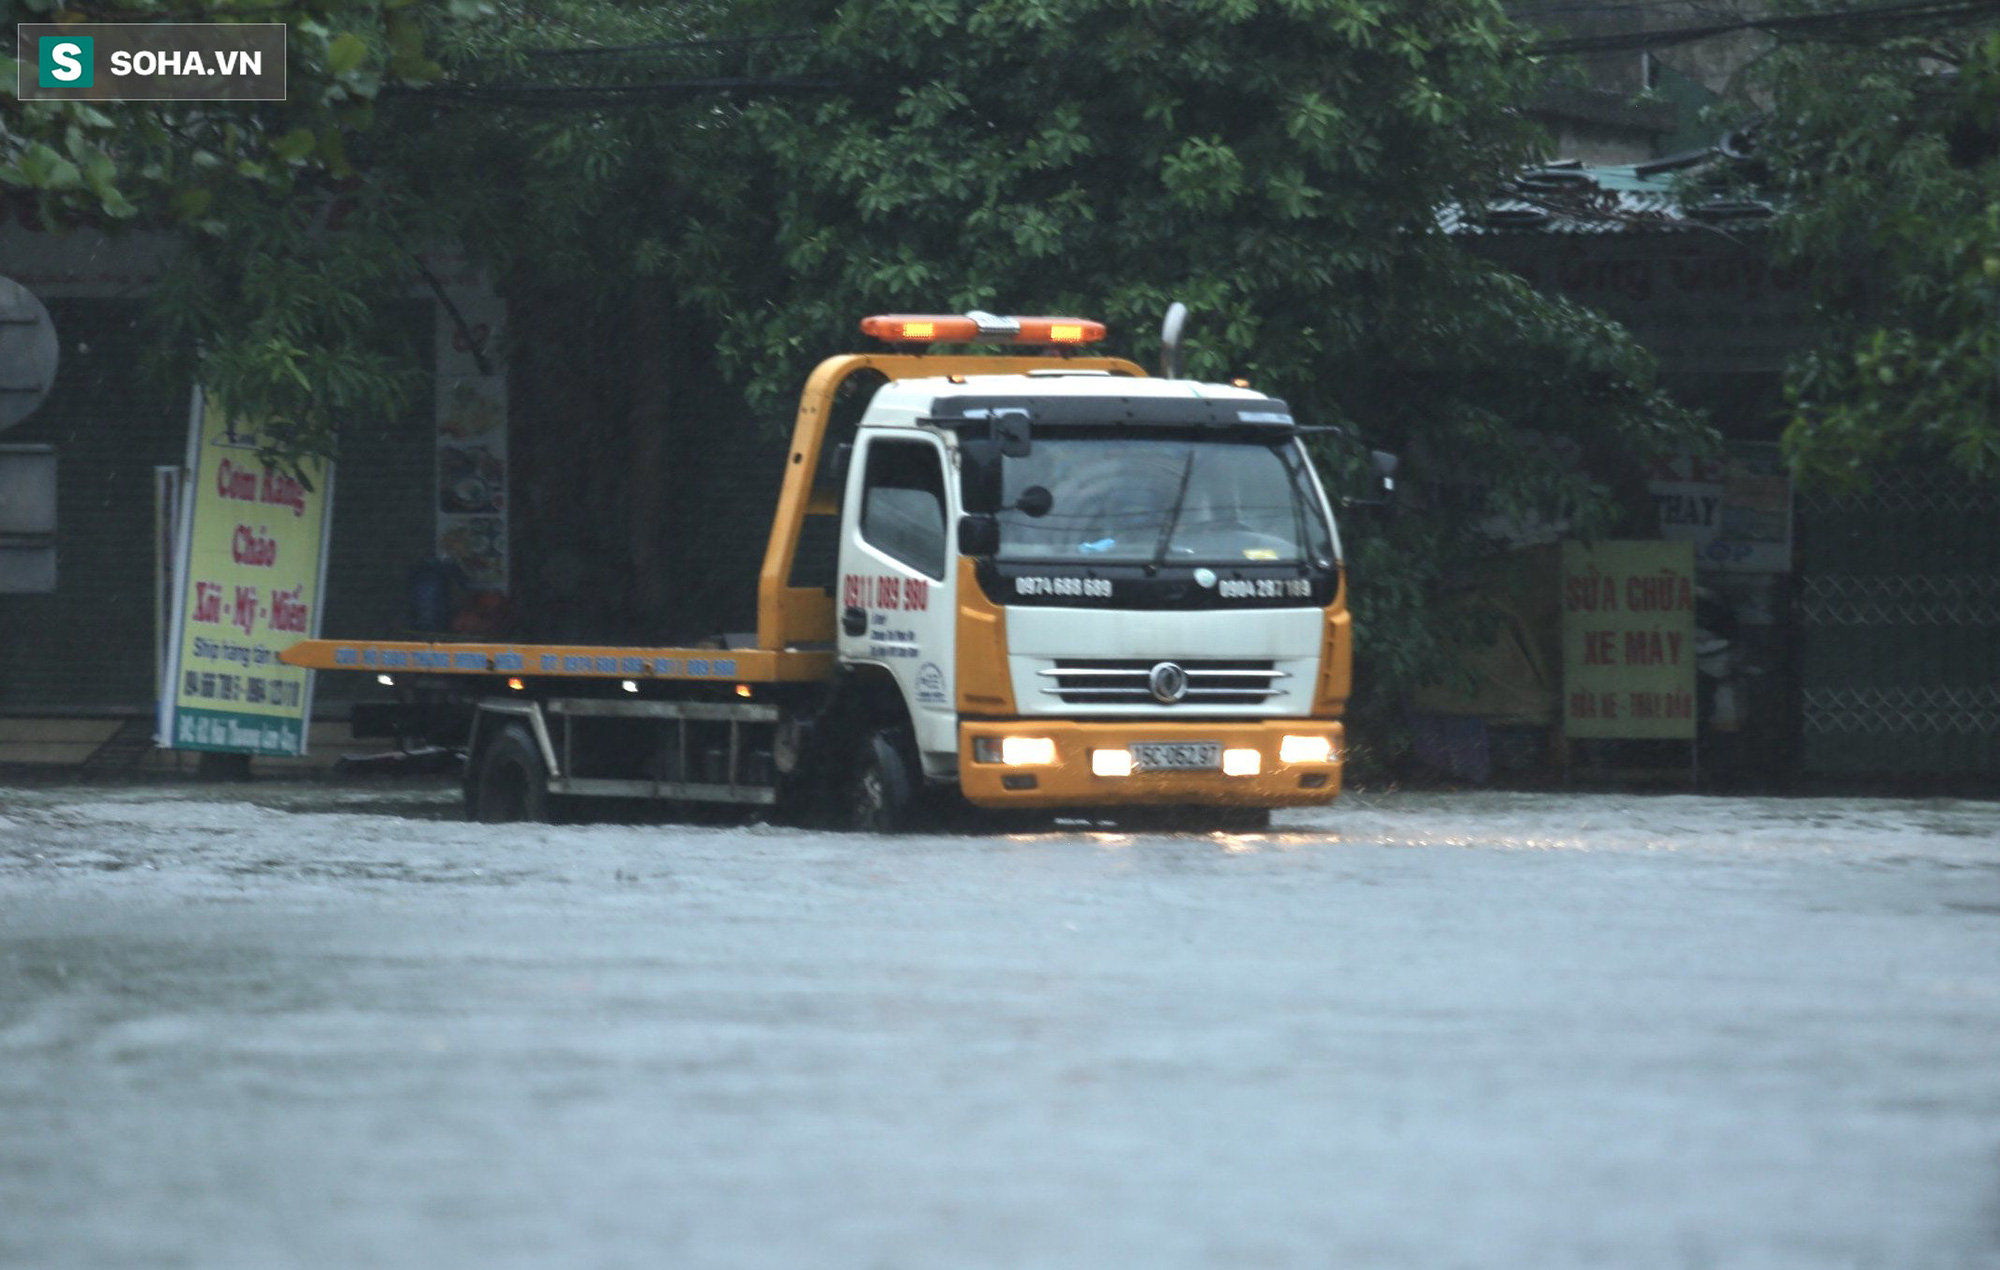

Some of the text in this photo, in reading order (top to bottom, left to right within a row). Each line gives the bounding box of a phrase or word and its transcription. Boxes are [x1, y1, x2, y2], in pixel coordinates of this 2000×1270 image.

[1015, 576, 1052, 596] 0974
[1566, 562, 1692, 613] SỬA CHỮA
[1584, 624, 1682, 666] XE MÁY
